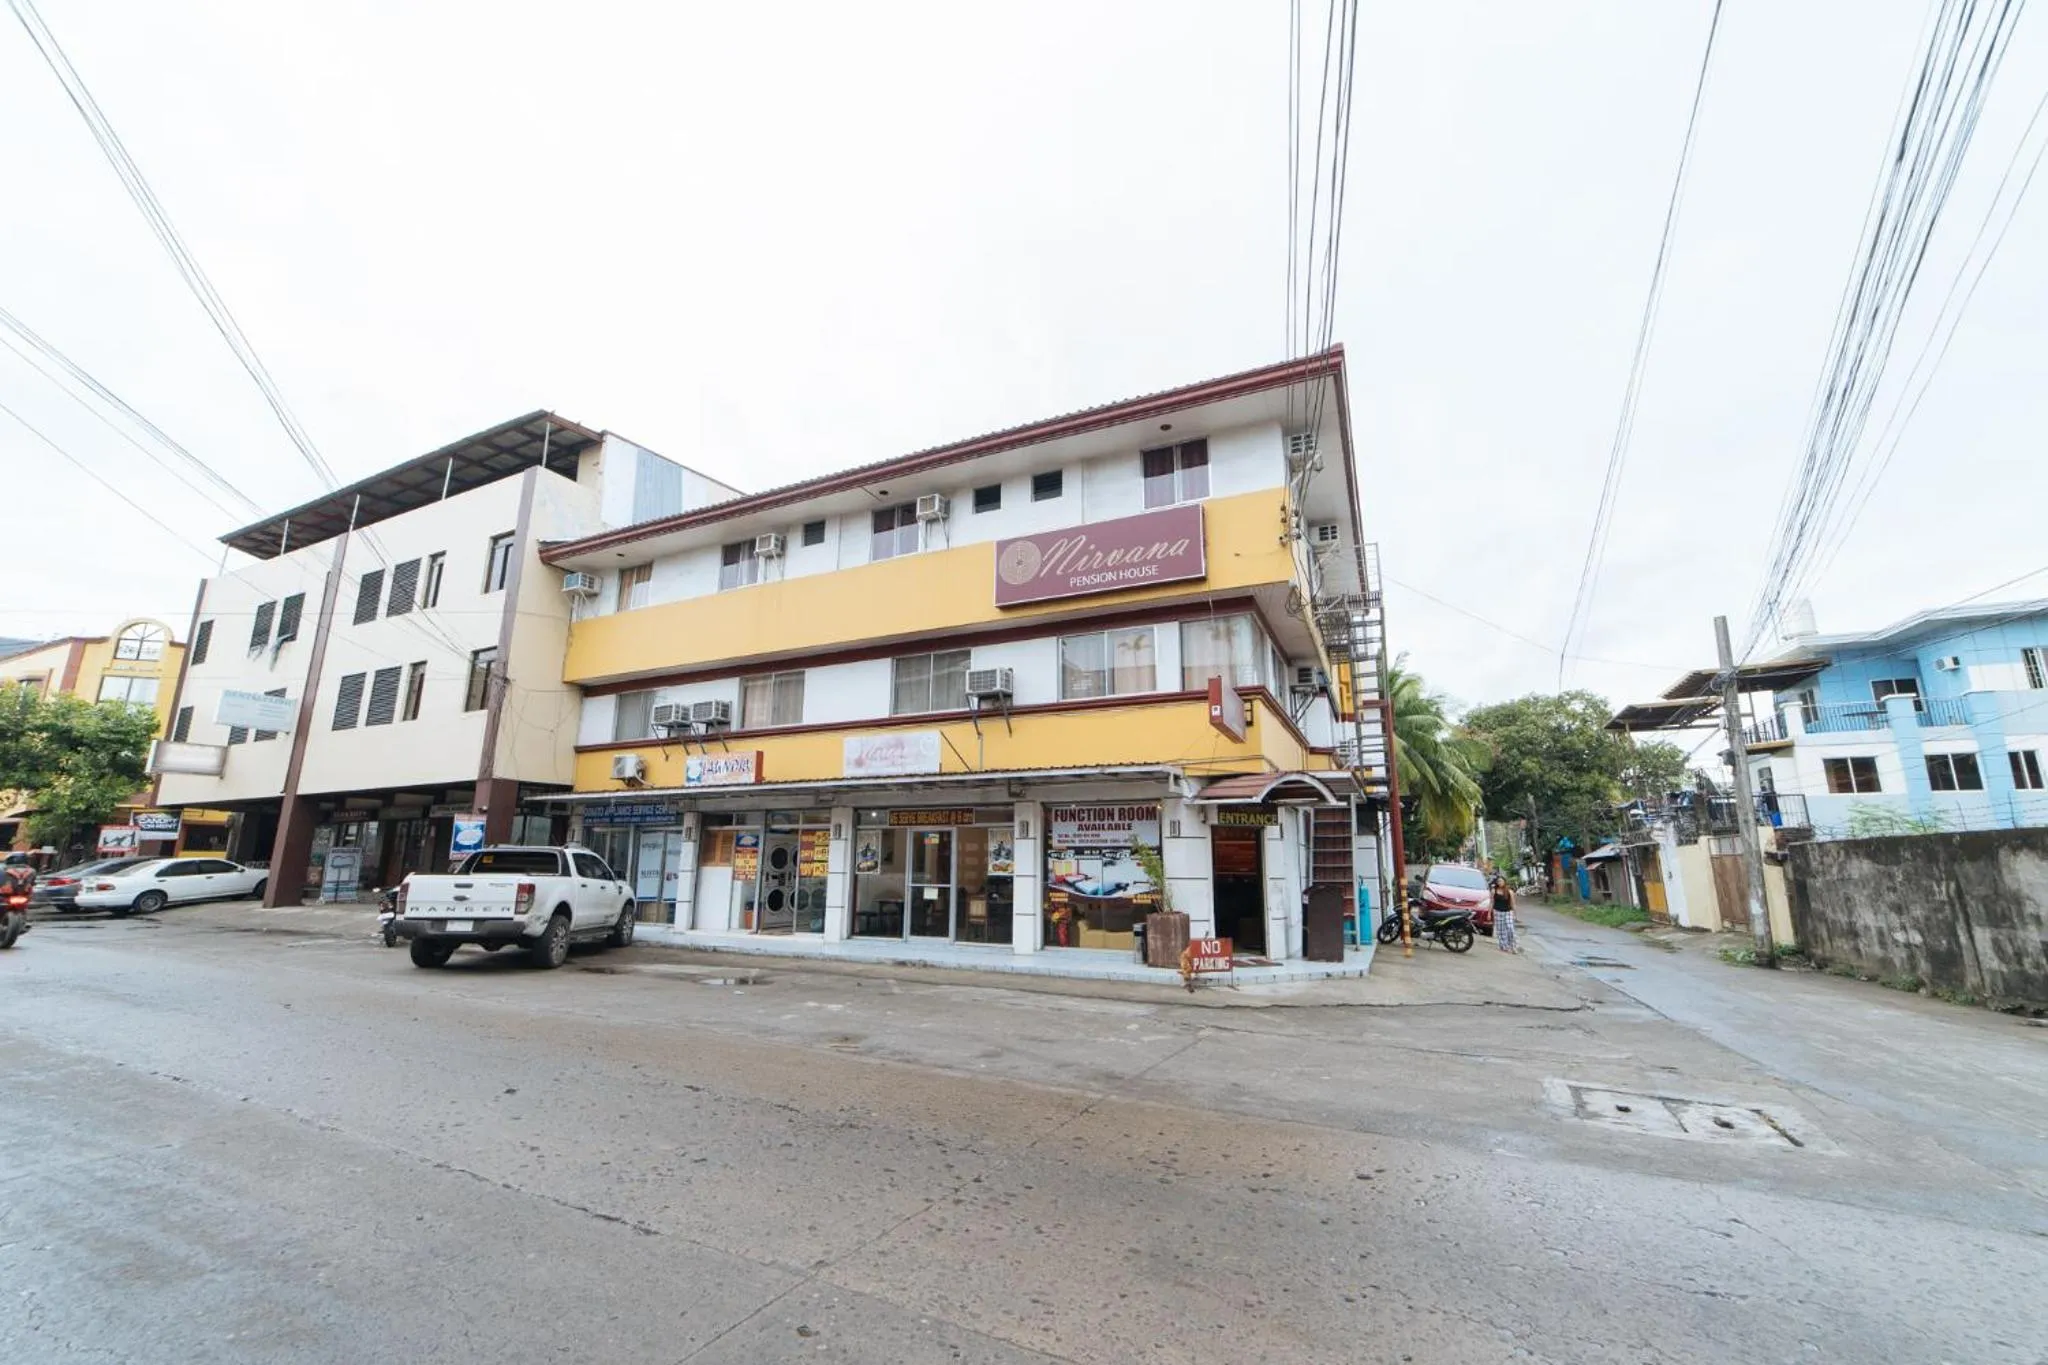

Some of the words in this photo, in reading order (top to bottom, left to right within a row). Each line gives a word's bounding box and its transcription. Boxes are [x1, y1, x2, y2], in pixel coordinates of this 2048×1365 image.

[1039, 534, 1190, 578] Nirvana
[1069, 573, 1117, 588] PENSION
[1119, 565, 1159, 580] HOUSE
[1054, 808, 1115, 823] FUNCTION
[1118, 806, 1157, 821] ROOM
[1219, 812, 1278, 825] ENTRANCE
[1077, 822, 1133, 832] AVAILABLE
[1201, 941, 1222, 954] NO
[1193, 956, 1230, 971] PARKING
